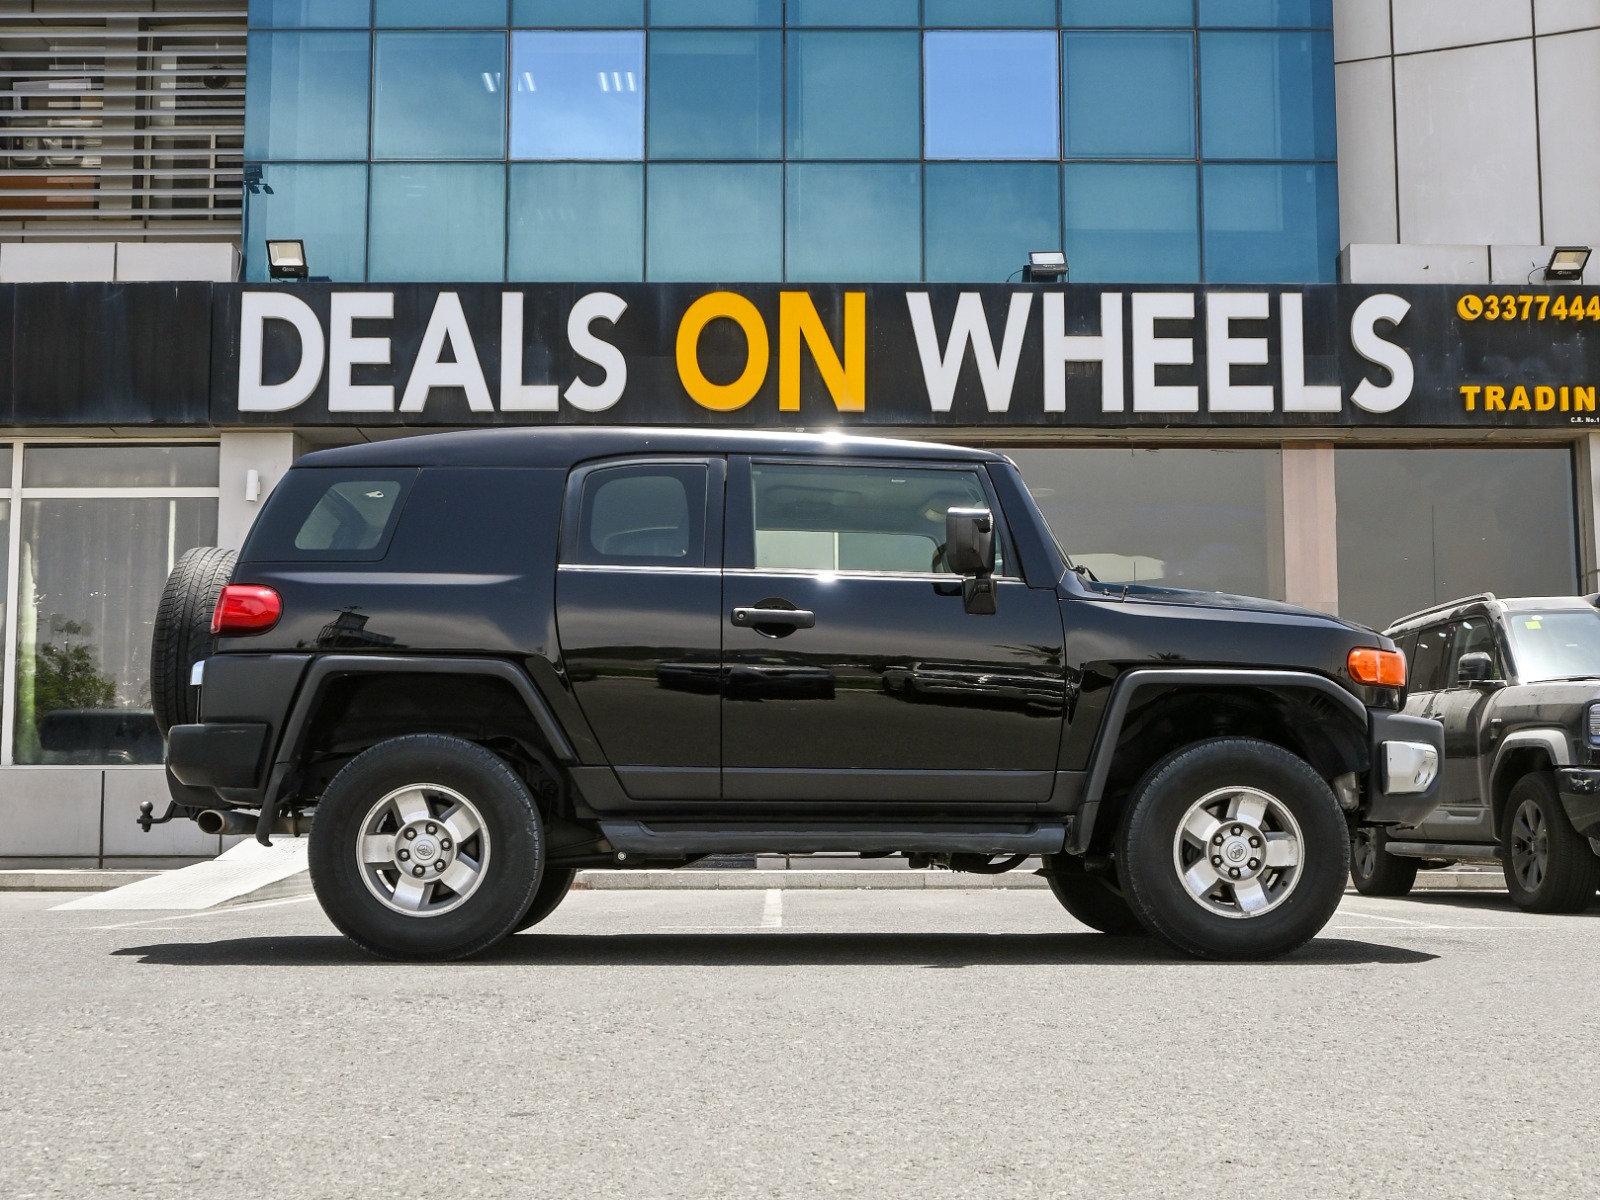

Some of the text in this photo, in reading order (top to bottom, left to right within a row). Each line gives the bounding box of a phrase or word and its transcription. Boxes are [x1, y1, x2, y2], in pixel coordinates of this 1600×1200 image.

[1483, 294, 1600, 321] 3377444
[237, 291, 1415, 413] DEALS ON WHEELS
[1459, 385, 1600, 412] TRADIN
